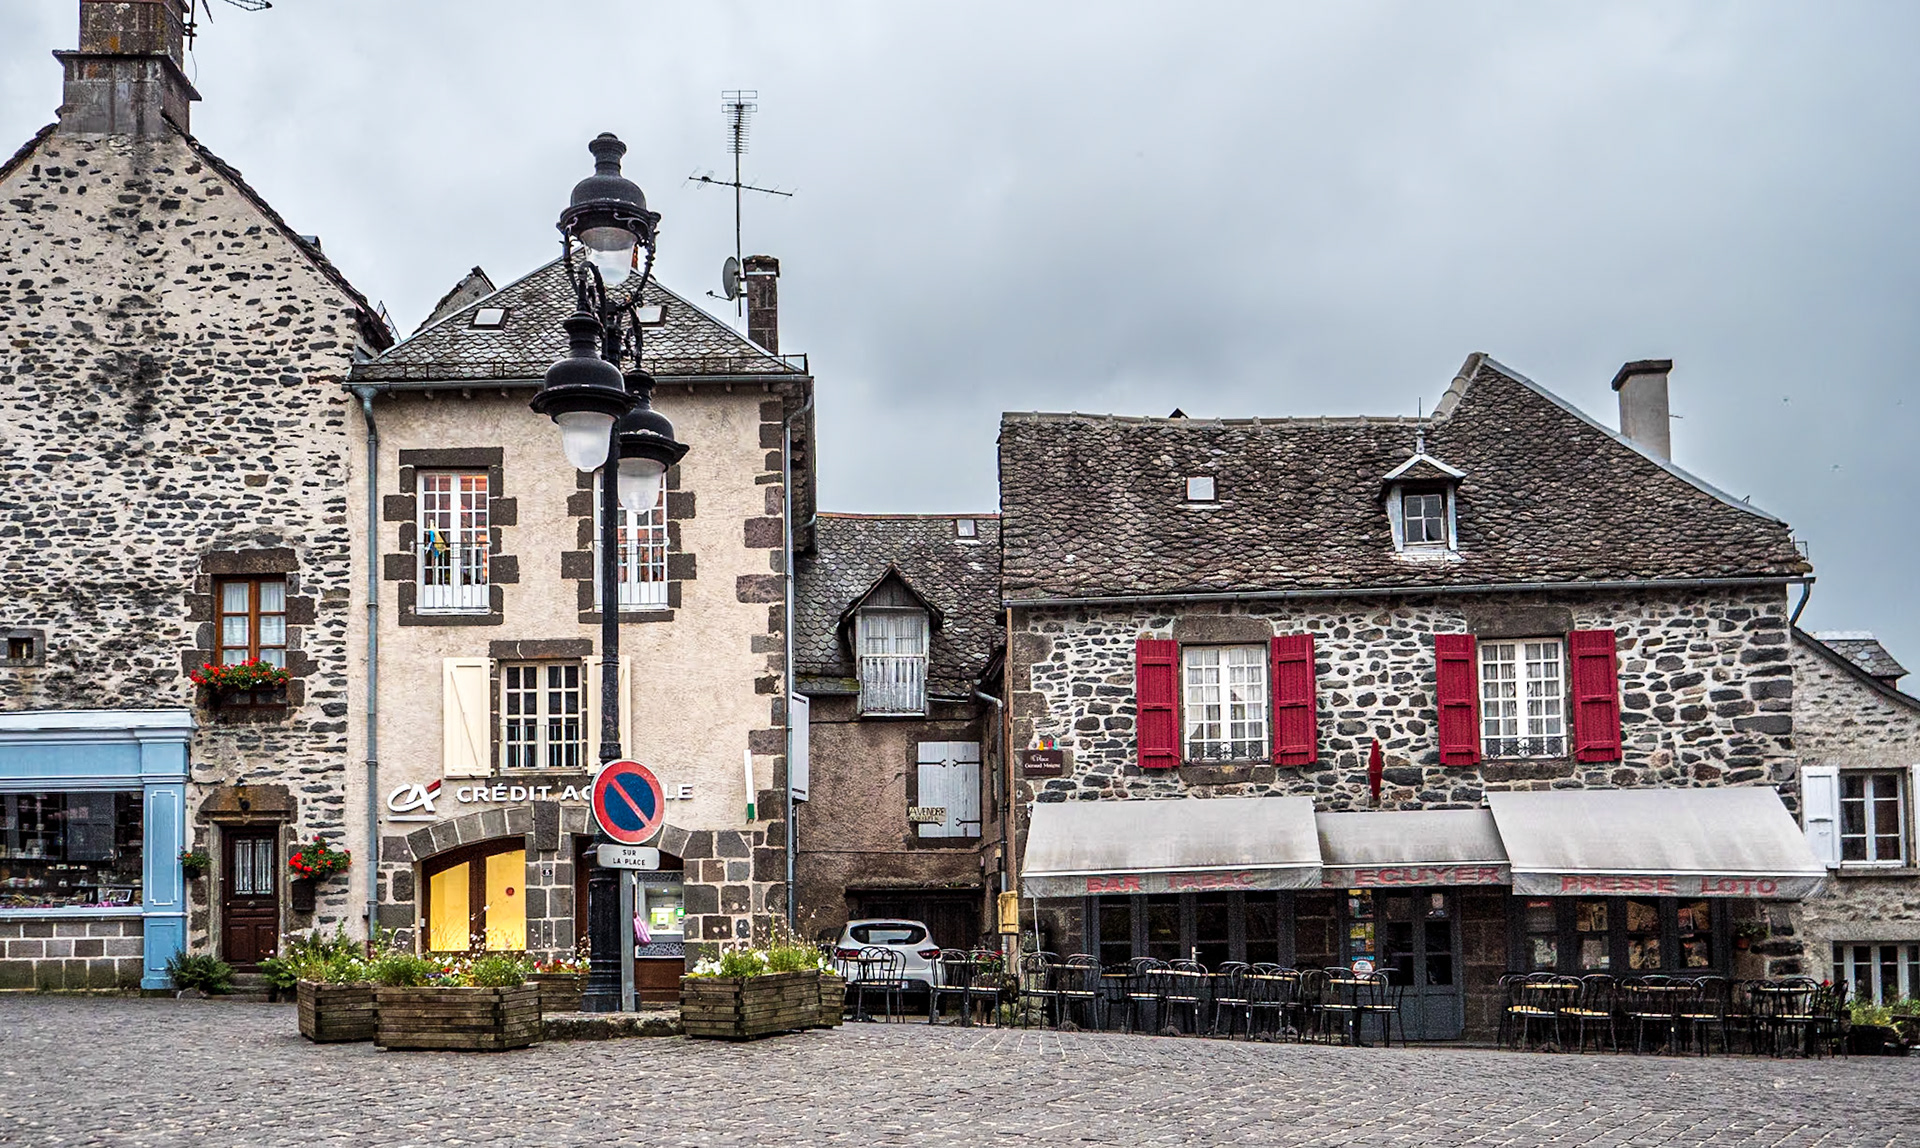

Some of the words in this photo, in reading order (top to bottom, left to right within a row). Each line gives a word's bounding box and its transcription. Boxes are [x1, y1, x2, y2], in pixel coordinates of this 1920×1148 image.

[456, 782, 552, 803] CRÉDIT
[612, 857, 622, 865] LA
[624, 858, 646, 867] PLACE
[622, 849, 637, 857] SUR
[1086, 875, 1140, 892] BAR
[1166, 871, 1255, 889] TABAC
[1561, 875, 1676, 893] PRESSE
[1701, 877, 1778, 895] LOTO
